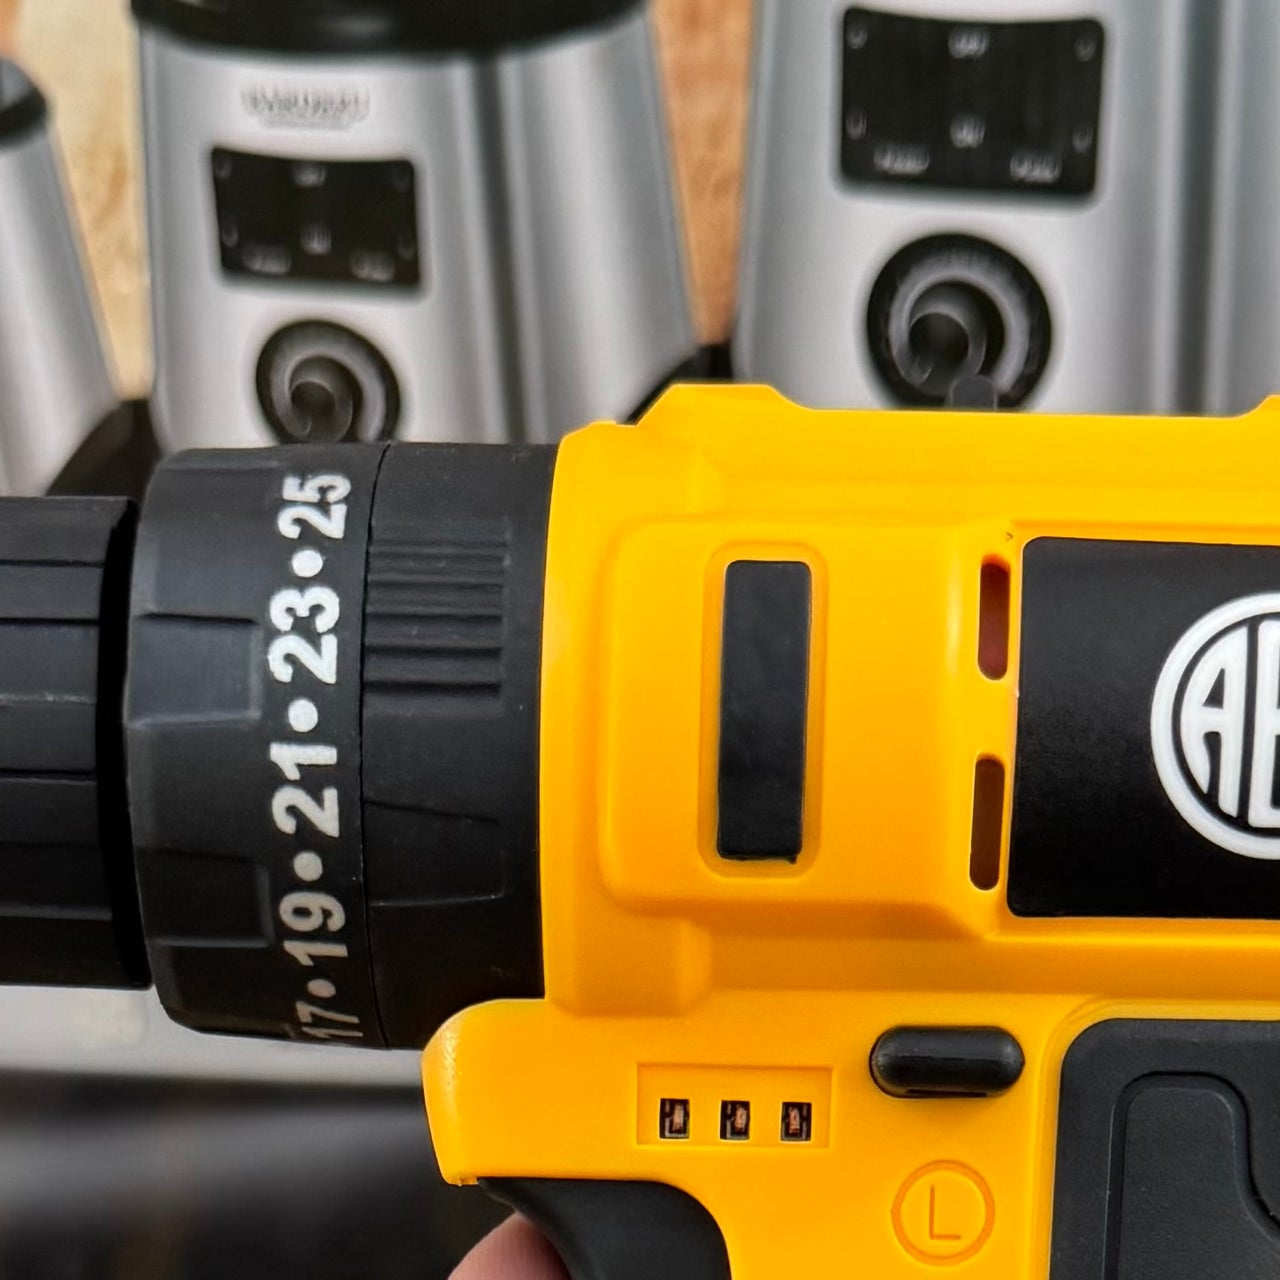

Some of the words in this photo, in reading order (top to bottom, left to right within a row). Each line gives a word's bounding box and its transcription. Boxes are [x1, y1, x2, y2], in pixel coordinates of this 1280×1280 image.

[277, 472, 352, 540] 25
[268, 586, 340, 685] 23
[269, 742, 340, 838] 21
[278, 891, 348, 967] 19
